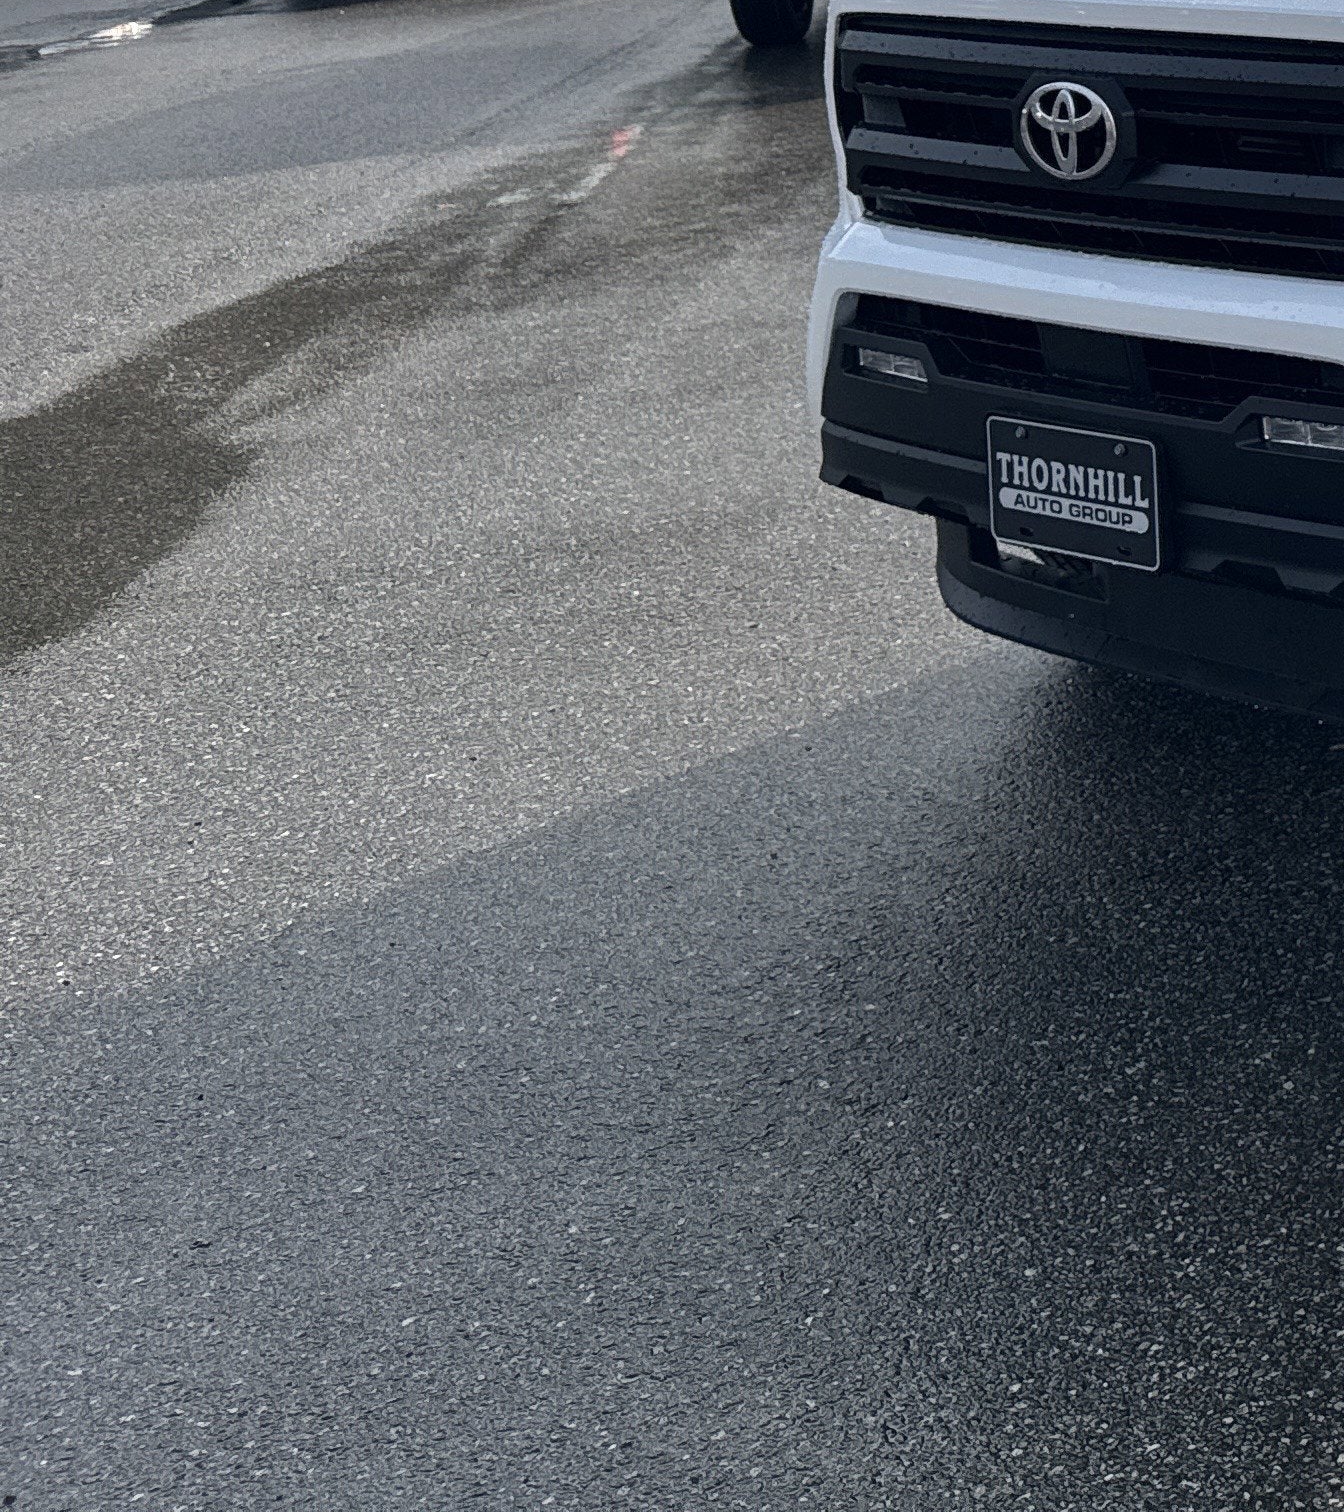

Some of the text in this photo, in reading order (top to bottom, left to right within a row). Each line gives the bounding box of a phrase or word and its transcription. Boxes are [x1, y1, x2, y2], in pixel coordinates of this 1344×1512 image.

[996, 452, 1149, 509] THORNHILL
[1014, 493, 1133, 527] AUTO GROUP
